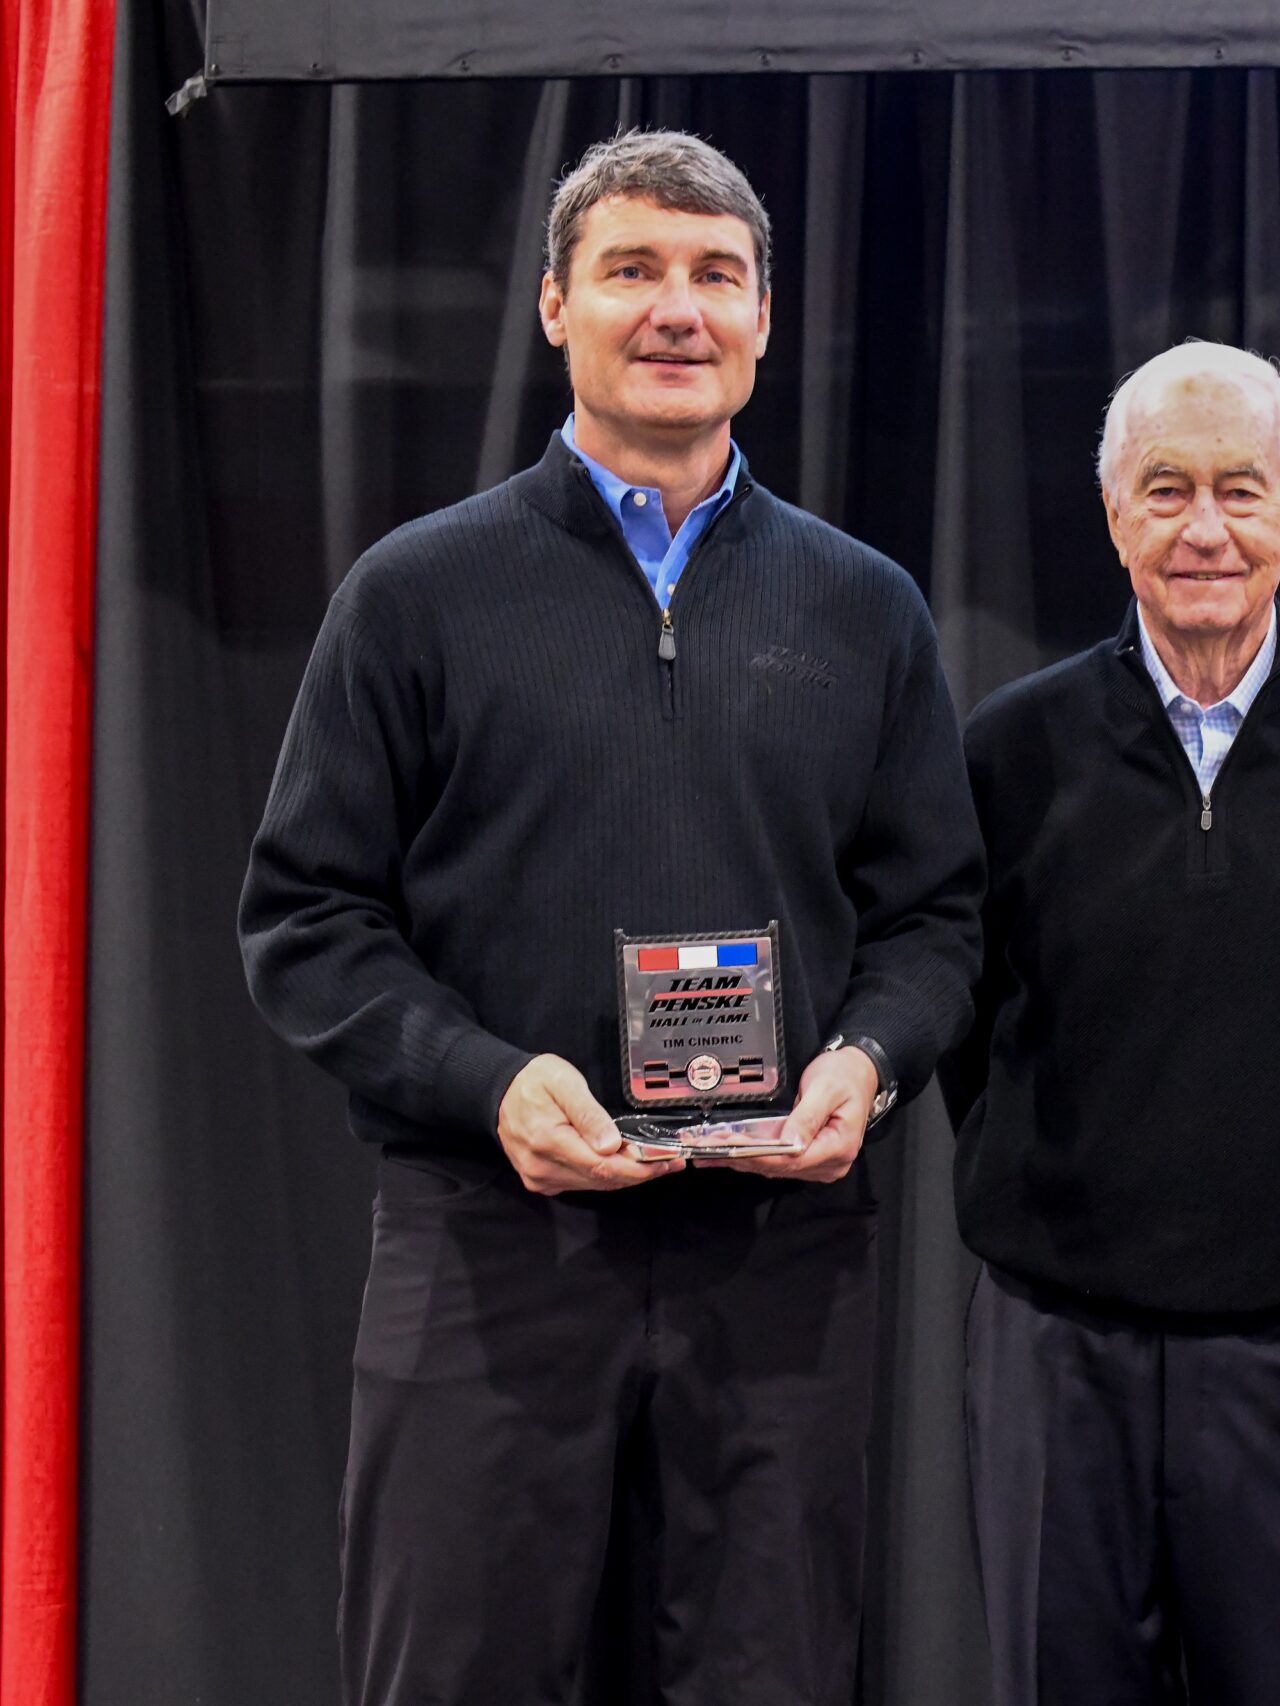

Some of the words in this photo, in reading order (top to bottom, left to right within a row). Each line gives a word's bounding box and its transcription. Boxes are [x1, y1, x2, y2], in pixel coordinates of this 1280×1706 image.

[669, 975, 743, 992] TEAM
[648, 994, 750, 1013] PENSKE
[650, 1016, 688, 1028] HALL
[706, 1012, 751, 1025] FAME
[663, 1038, 685, 1048] TIM
[688, 1034, 744, 1047] CINDRIC
